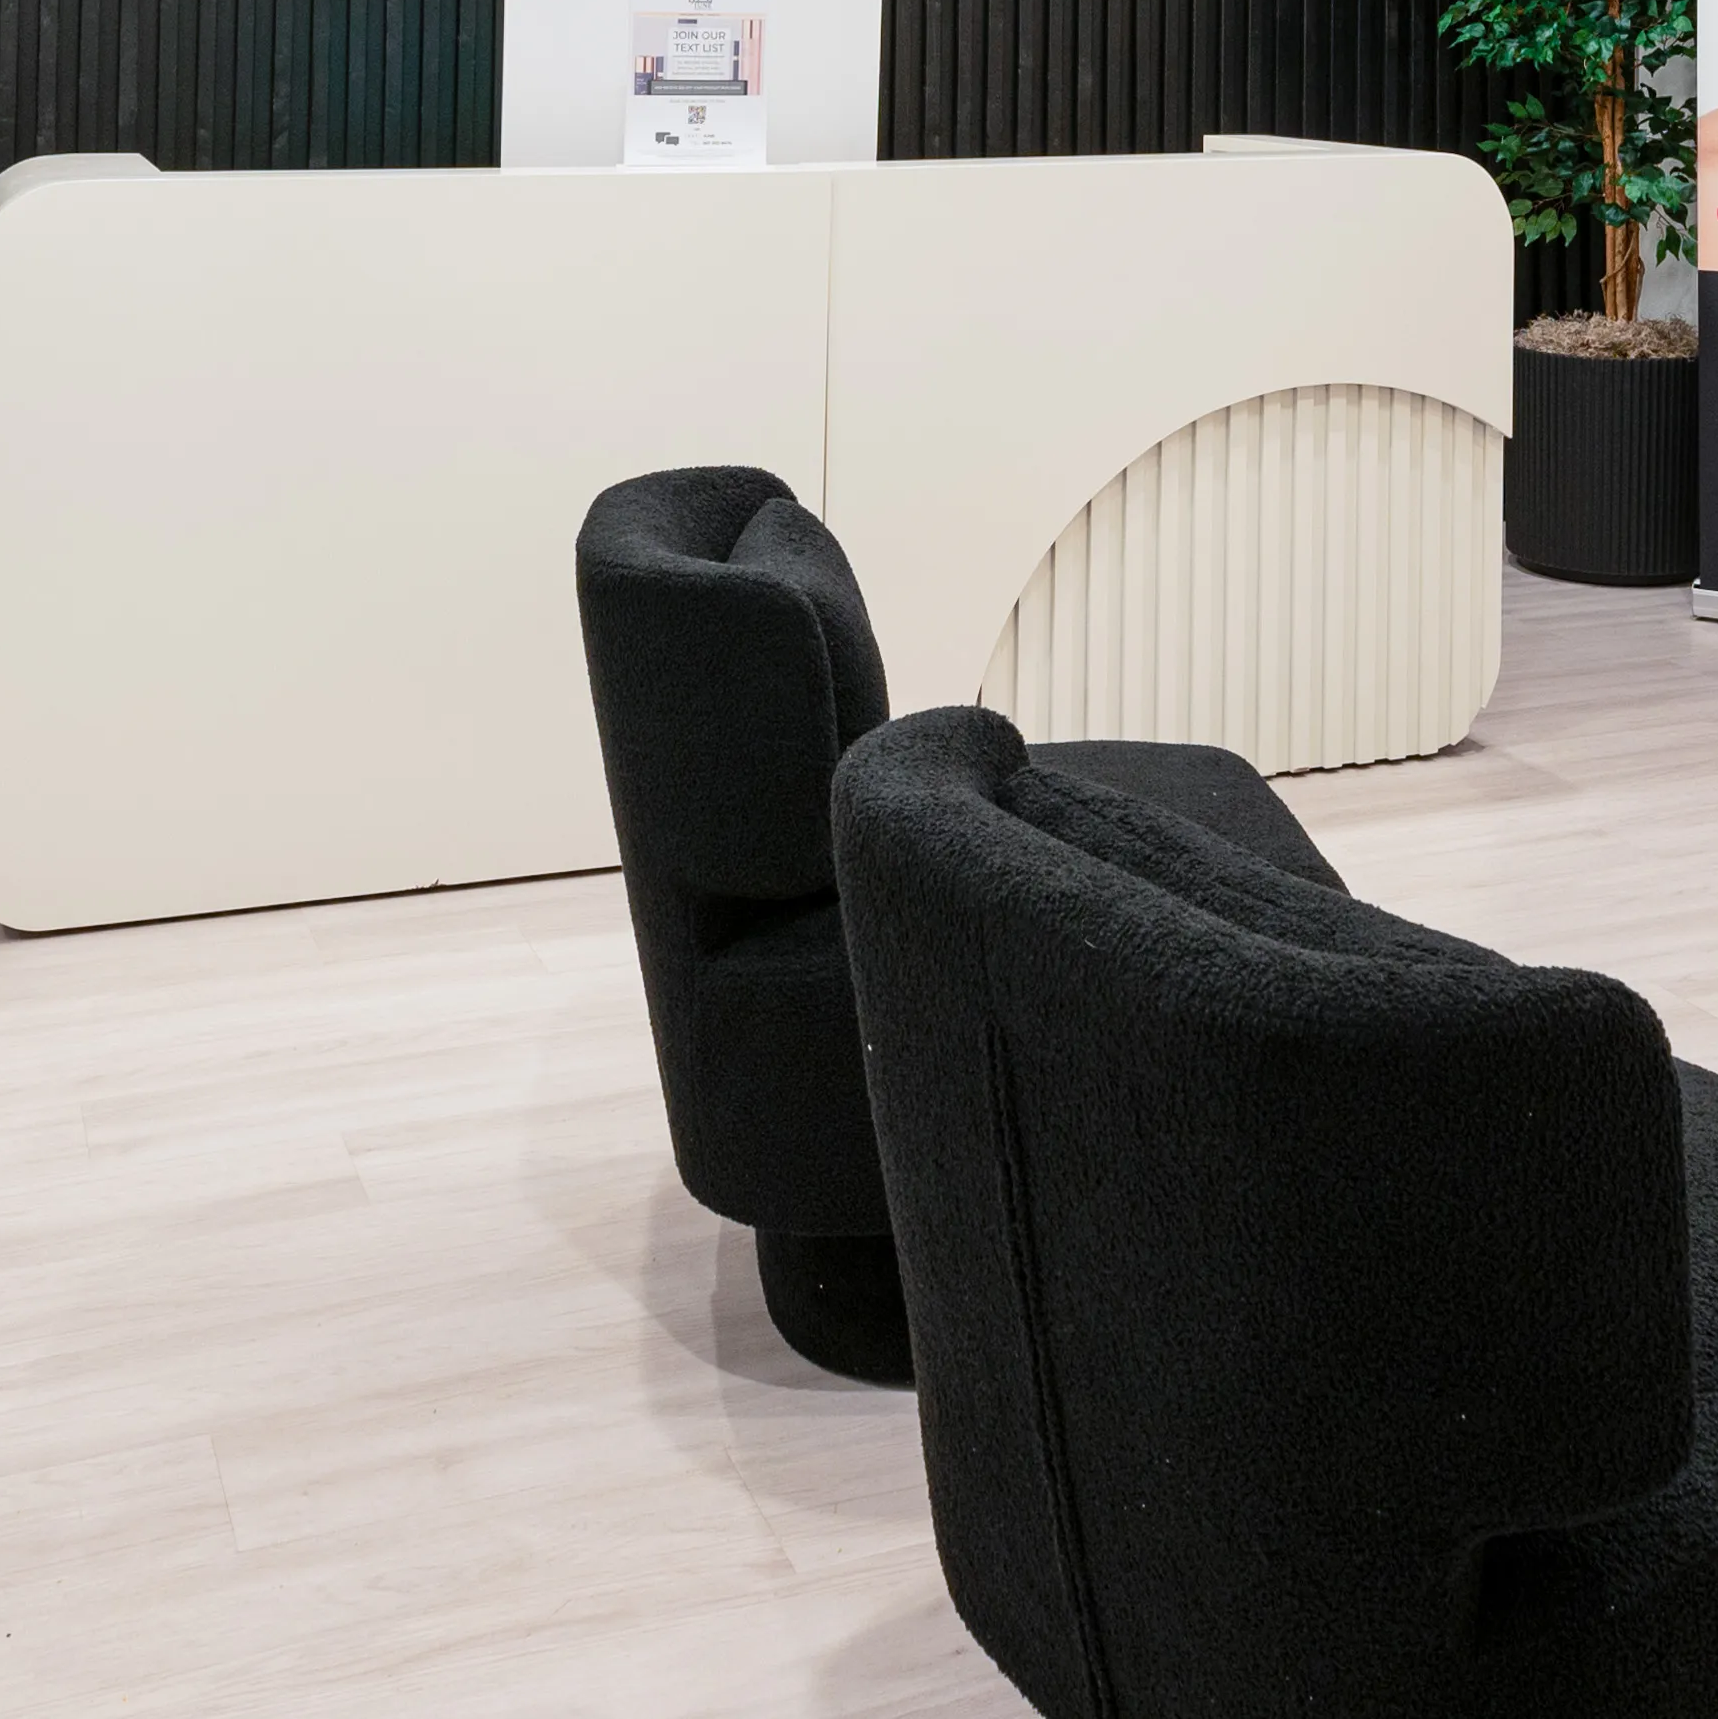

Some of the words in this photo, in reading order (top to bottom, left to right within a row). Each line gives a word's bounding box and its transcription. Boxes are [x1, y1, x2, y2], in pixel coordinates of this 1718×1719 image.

[672, 30, 699, 40] JOIN
[701, 30, 726, 40] OUR
[673, 43, 700, 53] TEXT
[702, 43, 725, 53] LIST
